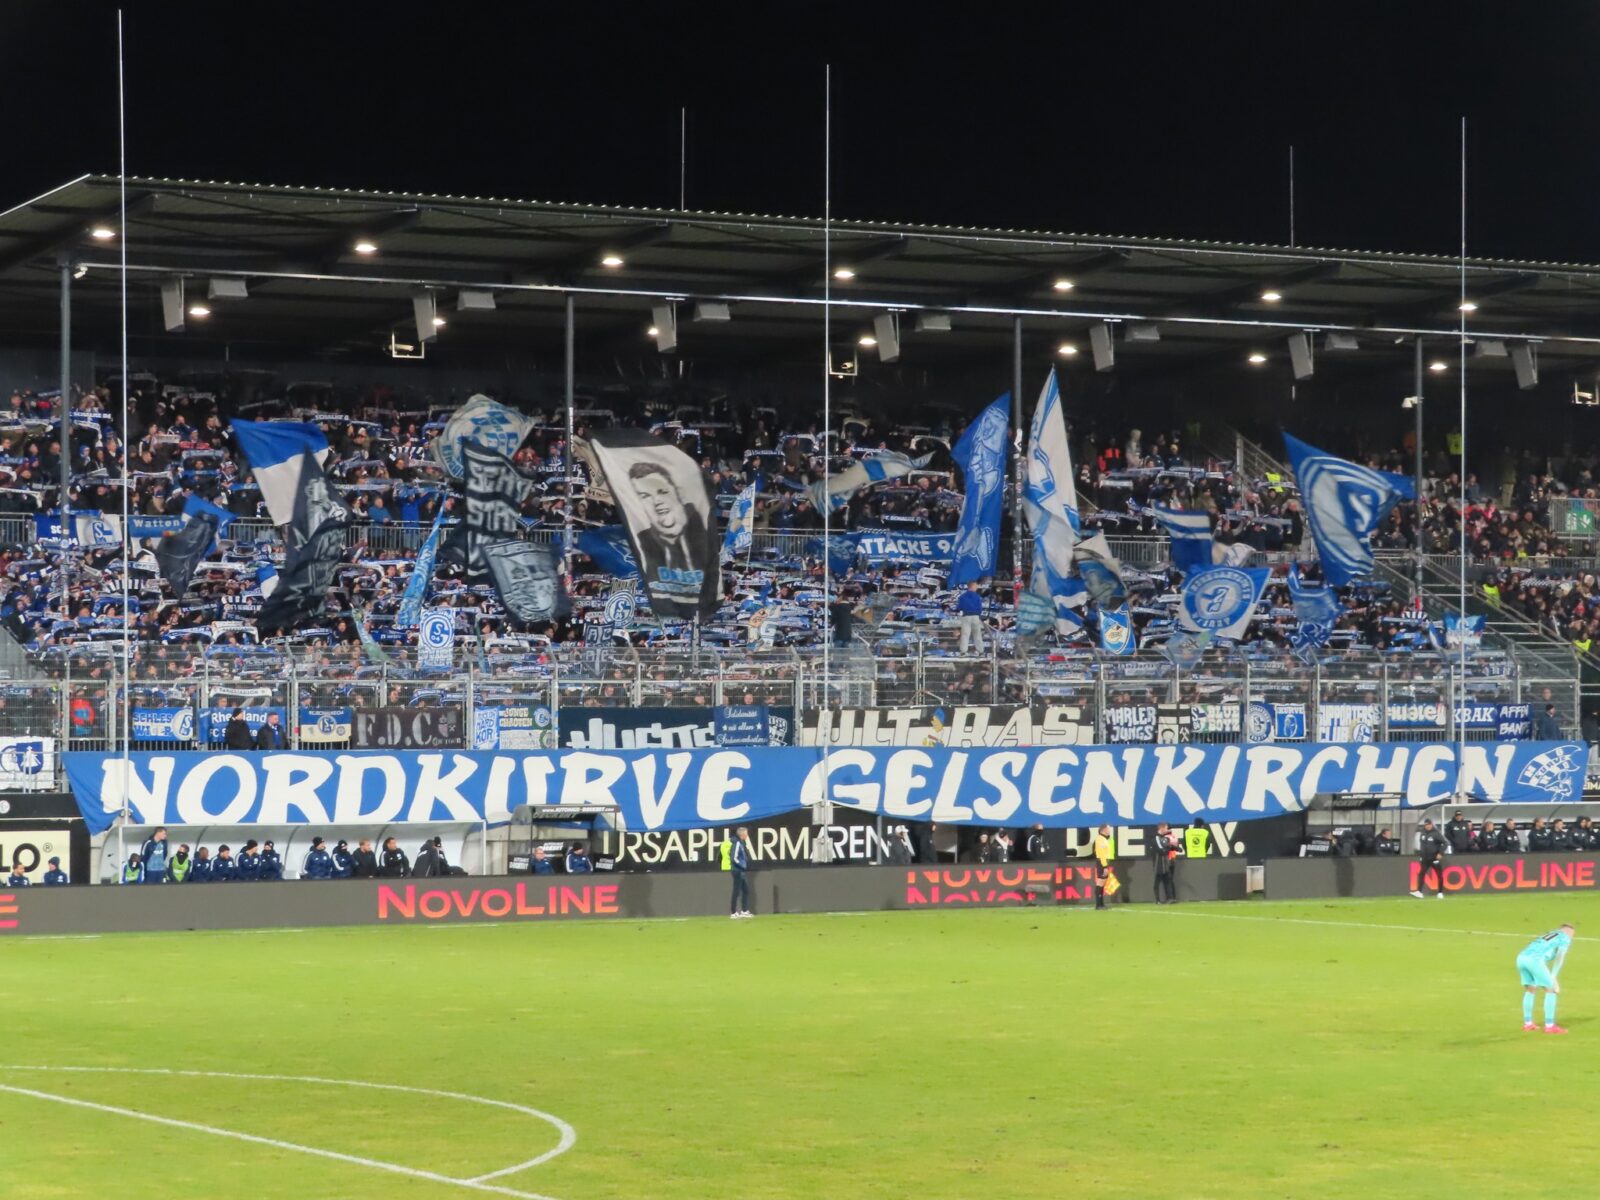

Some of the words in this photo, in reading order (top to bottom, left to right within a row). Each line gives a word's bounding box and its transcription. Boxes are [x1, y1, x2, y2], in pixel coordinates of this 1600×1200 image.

[211, 710, 267, 724] Rheland
[1103, 706, 1157, 726] MARLER
[1110, 725, 1154, 742] JUNGS
[101, 750, 751, 829] NORDKURVE
[800, 744, 1516, 822] GELSENKIRCHEN
[1066, 825, 1146, 858] DE
